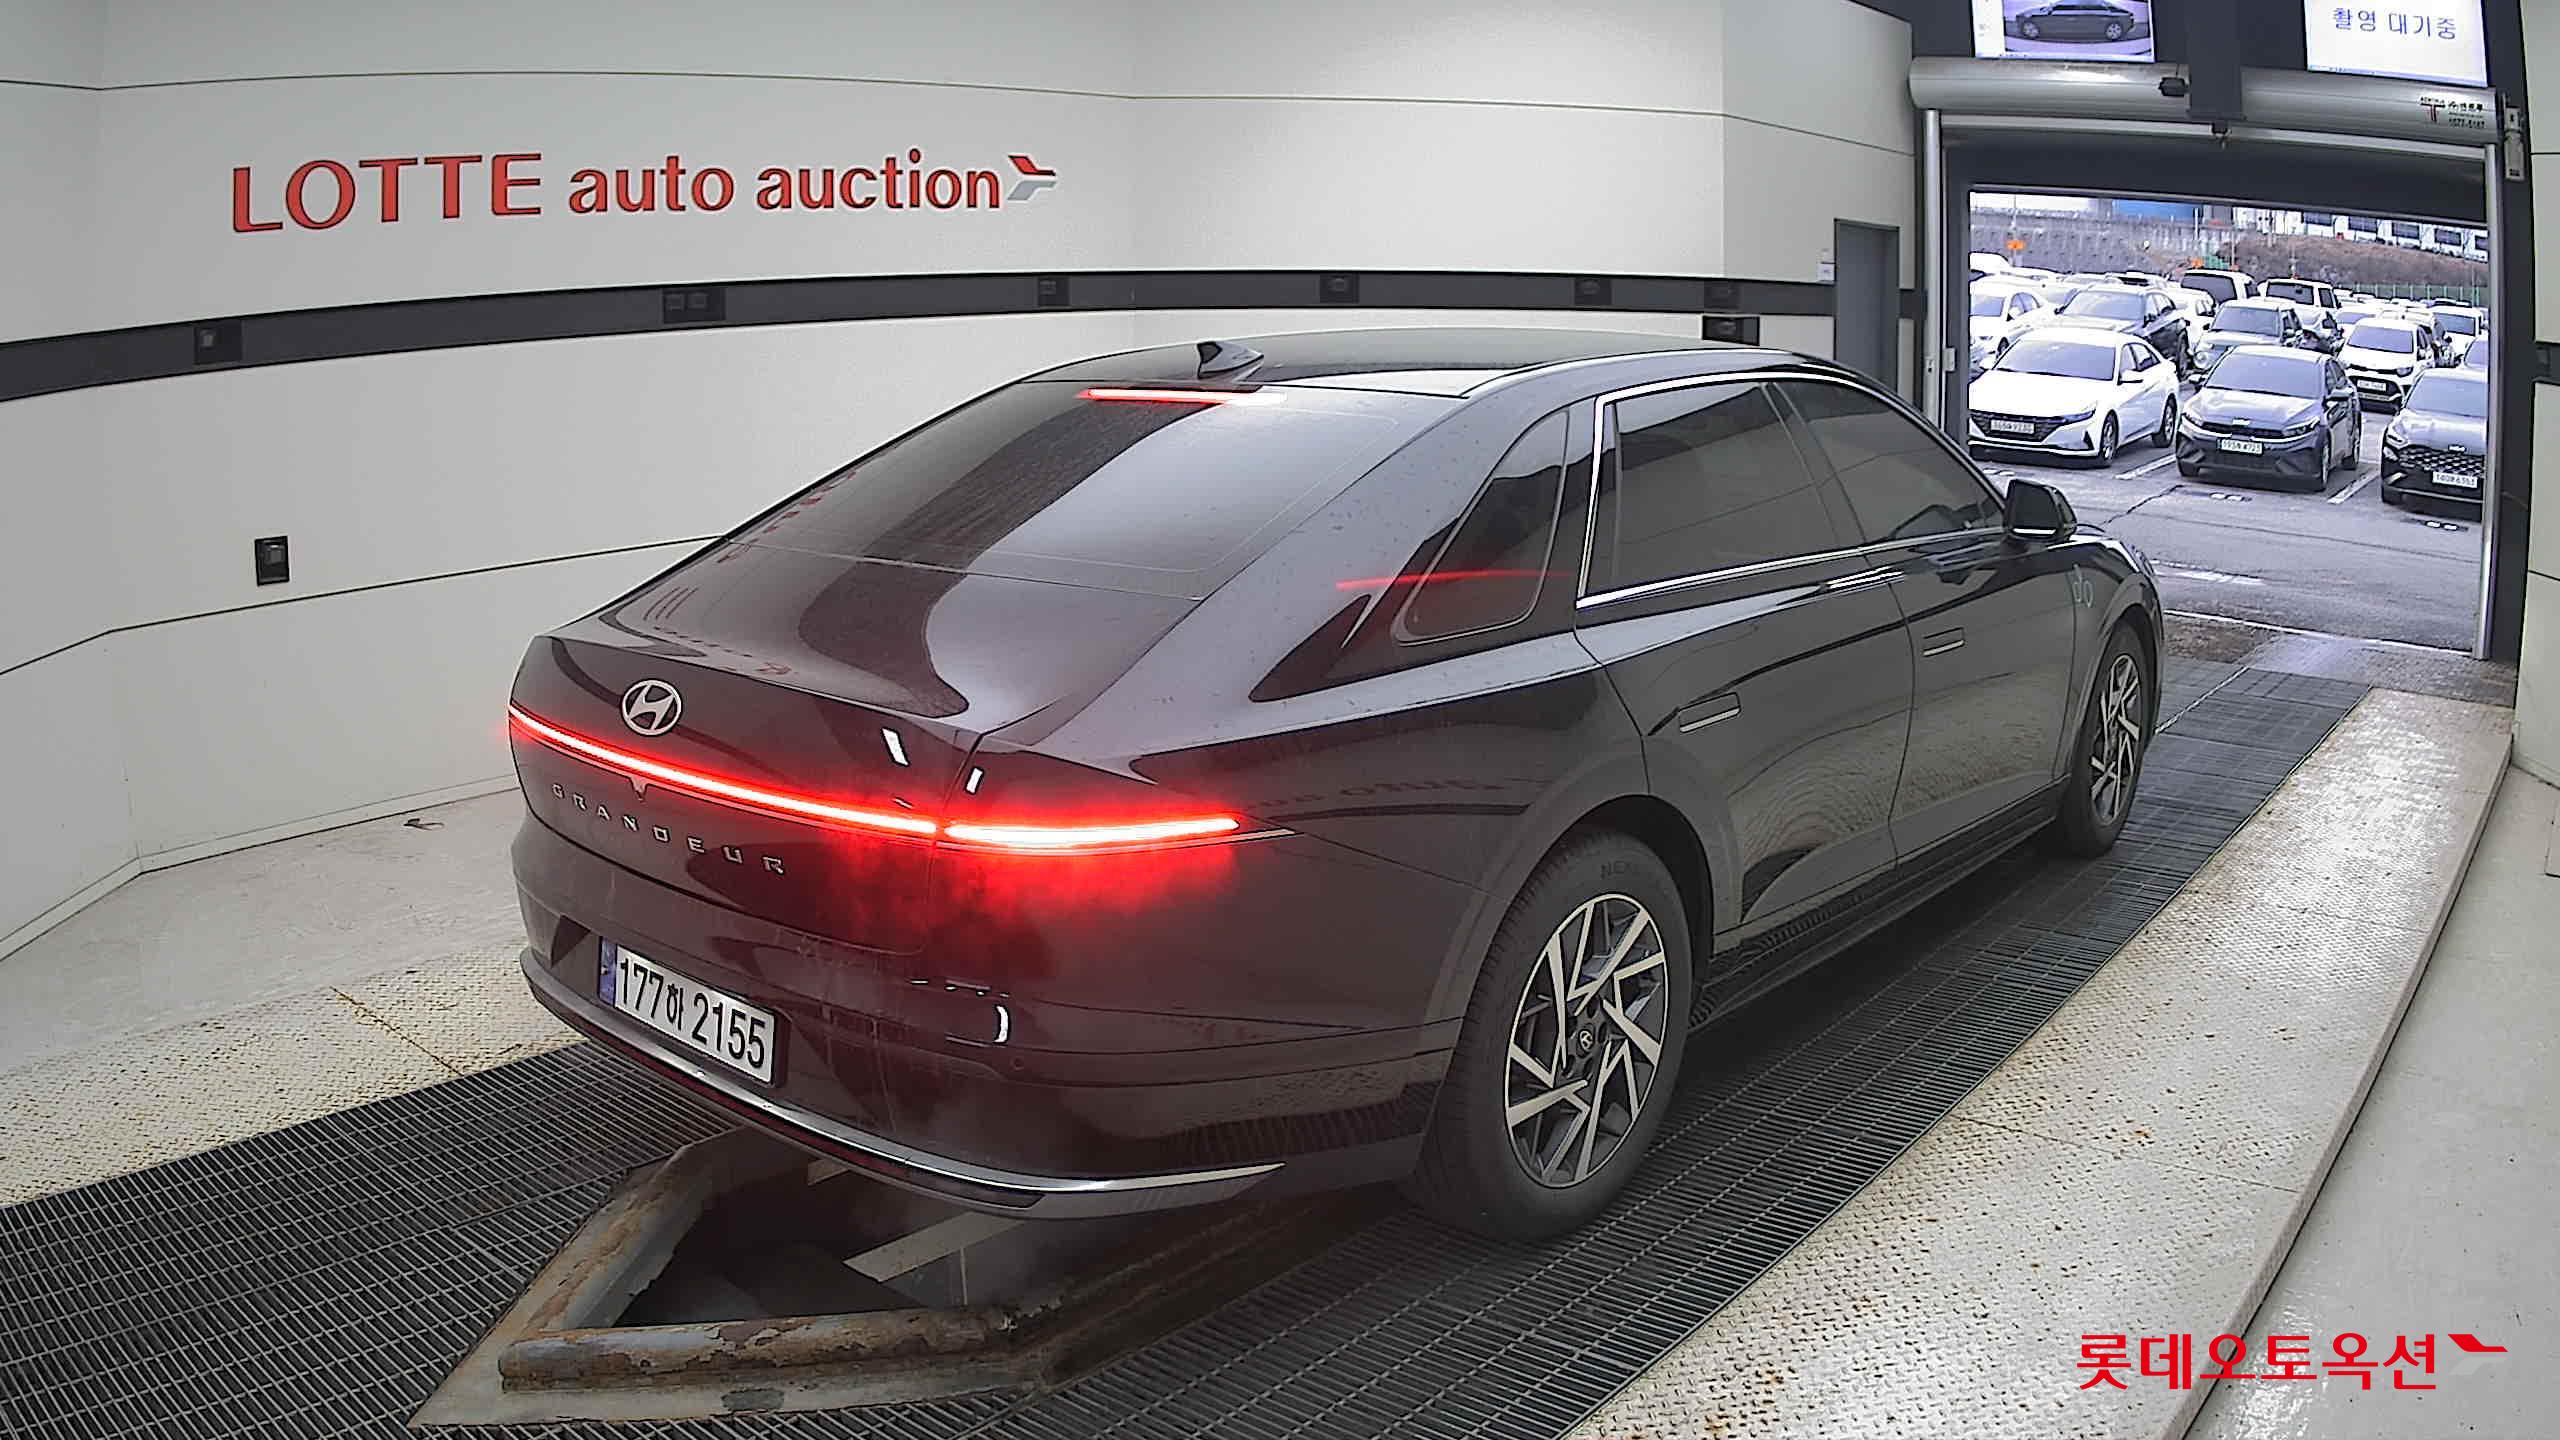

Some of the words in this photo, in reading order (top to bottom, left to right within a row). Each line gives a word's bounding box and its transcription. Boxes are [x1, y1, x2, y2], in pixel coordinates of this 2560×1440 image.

[2334, 8, 2377, 32] 촬영
[2388, 13, 2456, 40] 대기중
[233, 154, 541, 232] LOTTE
[569, 156, 734, 213] auto
[757, 148, 1001, 210] auction
[552, 783, 785, 874] GRANDEUR
[692, 992, 766, 1069] 2155
